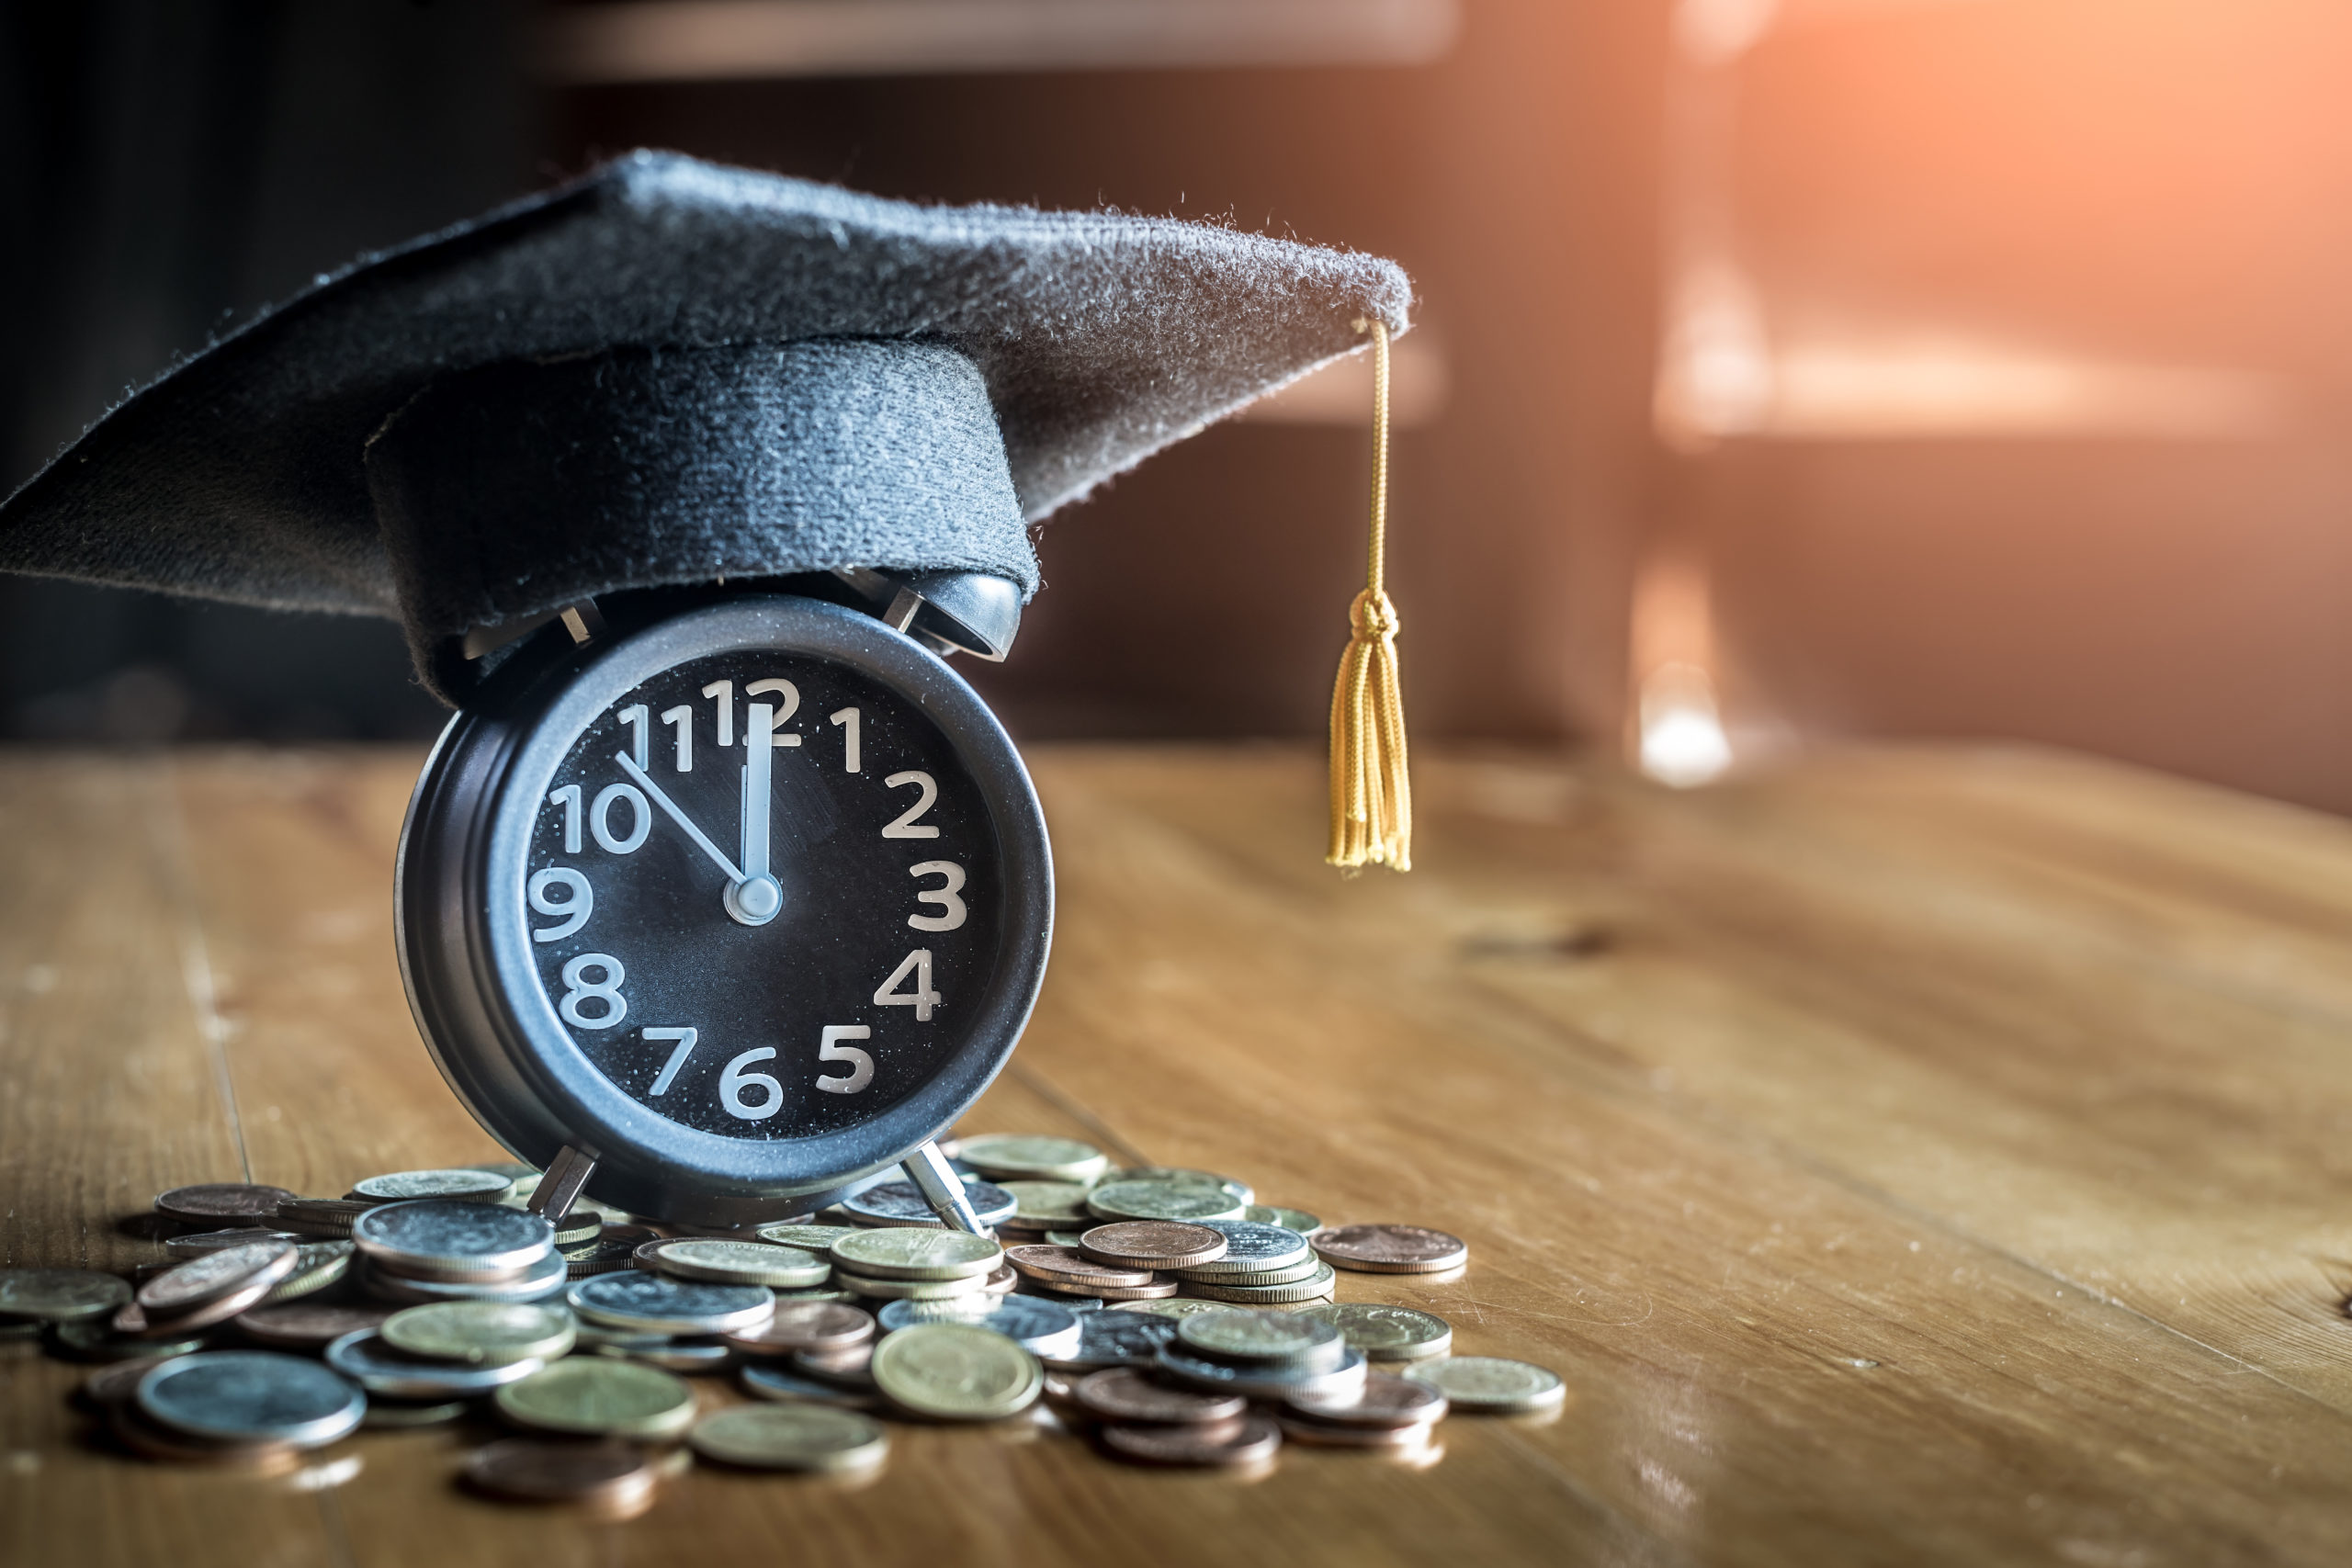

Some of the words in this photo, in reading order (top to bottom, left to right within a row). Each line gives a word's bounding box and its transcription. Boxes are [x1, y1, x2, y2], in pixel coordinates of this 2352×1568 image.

[616, 704, 693, 772] 11
[701, 677, 802, 747] 12
[830, 706, 861, 773] 1
[550, 784, 651, 853] 10
[882, 770, 940, 838] 2
[526, 867, 594, 942] 9
[908, 861, 967, 931] 3
[559, 953, 628, 1030] 8
[874, 949, 942, 1021] 4
[642, 1027, 698, 1096] 7
[718, 1047, 783, 1120] 6
[816, 1024, 875, 1094] 5
